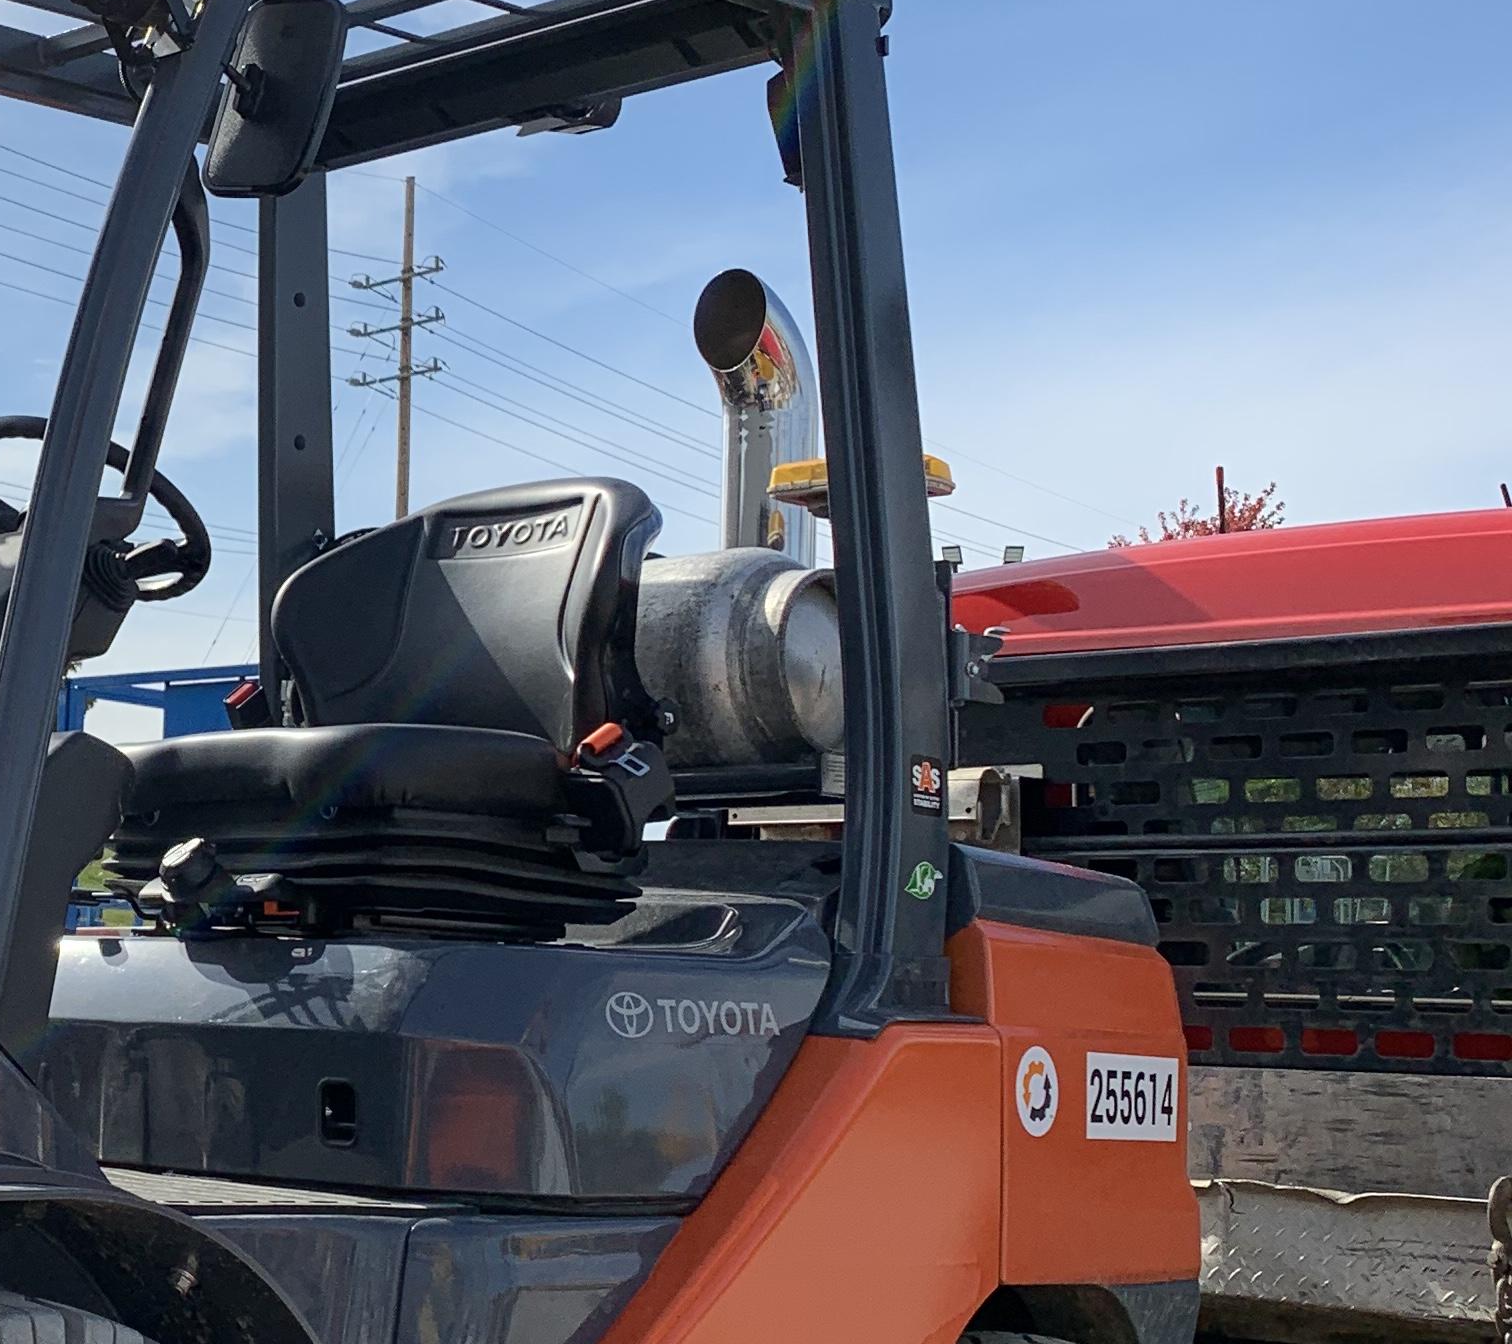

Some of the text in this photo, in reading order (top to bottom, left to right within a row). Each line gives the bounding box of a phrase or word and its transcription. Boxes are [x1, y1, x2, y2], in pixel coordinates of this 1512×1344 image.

[451, 512, 569, 550] TOYOTA
[912, 762, 941, 793] SAS
[657, 998, 780, 1036] TOYOTA
[1090, 1068, 1173, 1126] 255614
